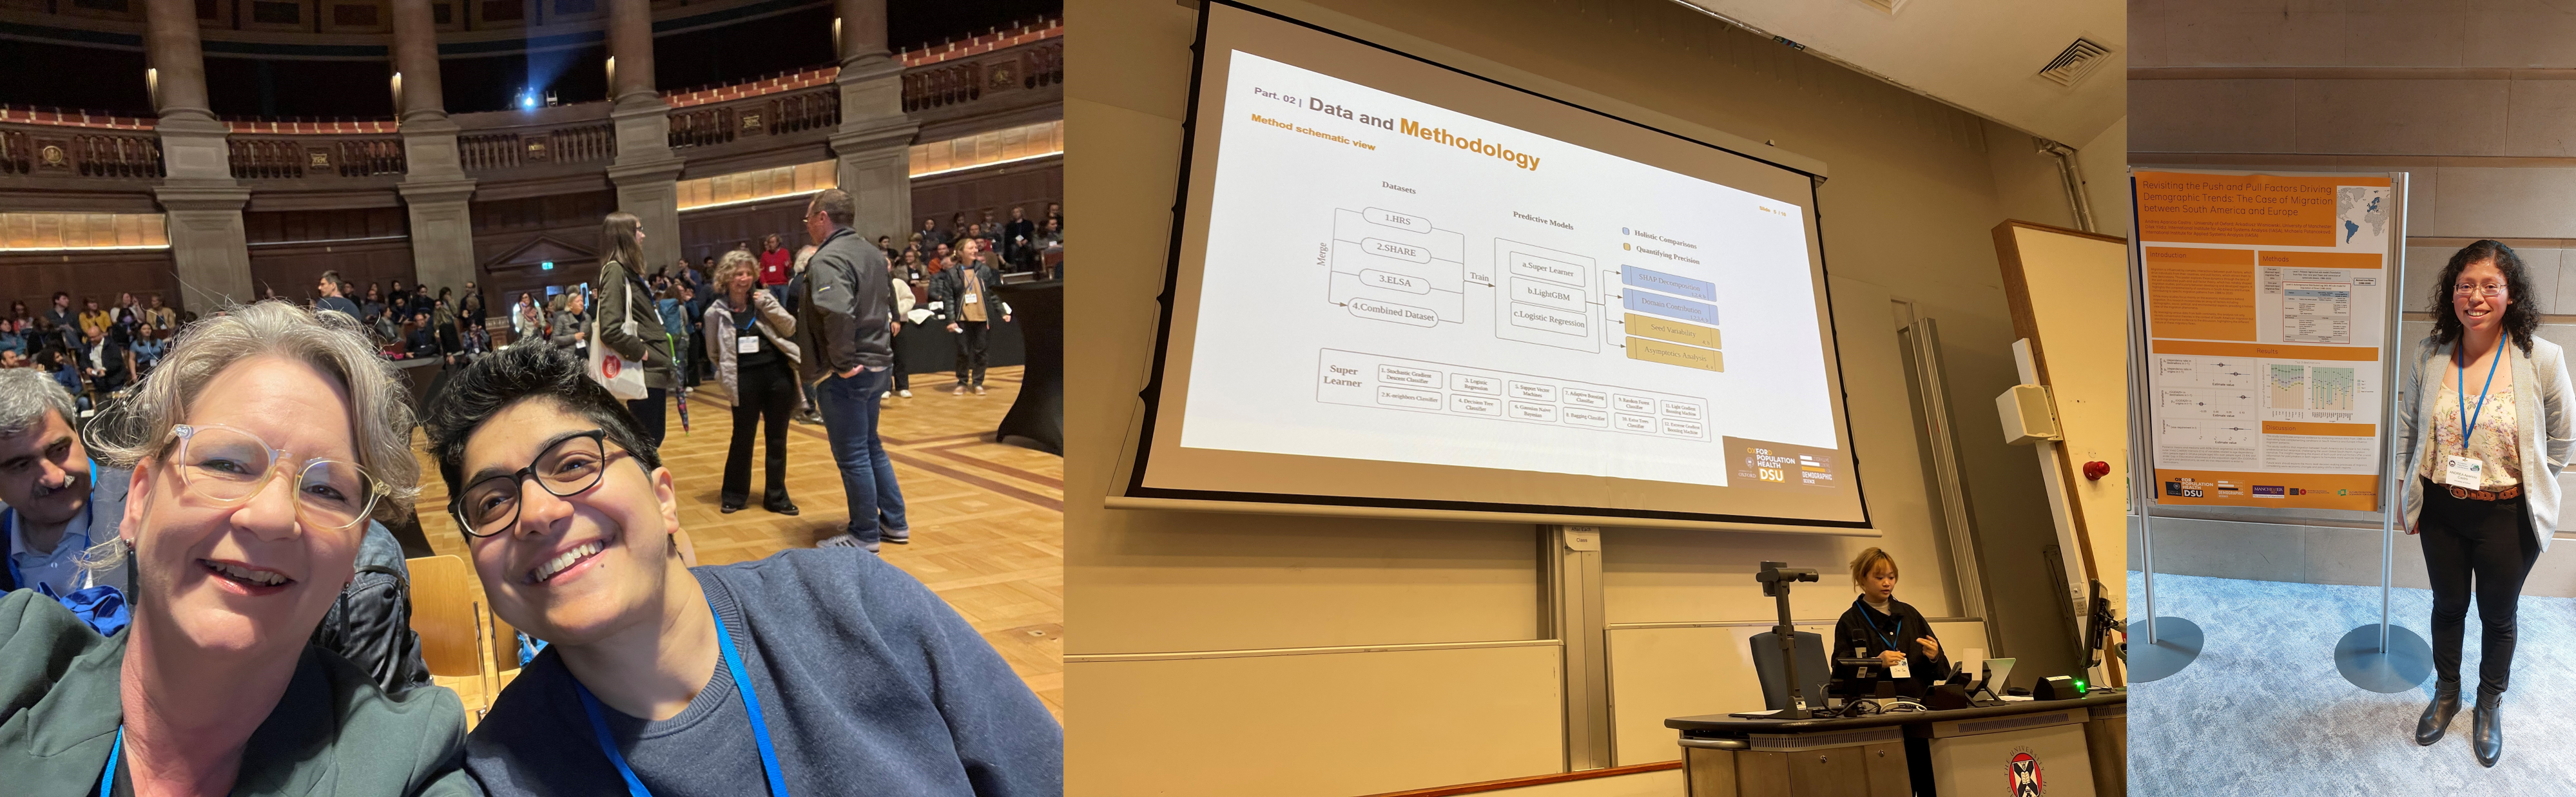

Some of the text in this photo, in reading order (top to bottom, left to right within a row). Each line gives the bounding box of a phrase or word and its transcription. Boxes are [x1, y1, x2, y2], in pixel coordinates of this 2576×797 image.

[1251, 113, 1376, 151] Method schematic view
[1254, 87, 1279, 101] Part.
[1283, 94, 1295, 104] 02
[1309, 97, 1353, 120] Data
[1359, 110, 1394, 131] and
[1400, 117, 1540, 171] Methodology
[1382, 181, 1417, 194] Datasets
[2143, 181, 2184, 191] Revisiting
[2202, 182, 2223, 191] Push
[2226, 183, 2243, 191] and
[2246, 183, 2261, 191] Pull
[2265, 184, 2298, 193] Factors
[2300, 184, 2332, 195] Driving
[2144, 192, 2332, 207] Demographic Trends: The Case of Migration
[2144, 204, 2298, 217] between South America and Europe
[1385, 214, 1411, 226] 1.HRS
[1513, 211, 1574, 231] Predictive Models
[1634, 229, 1698, 249] Holistic Comparisons
[1317, 242, 1328, 267] Merge
[1377, 242, 1417, 257] 2.SHARE
[1636, 245, 1700, 265] Quantifying Precision
[1470, 272, 1489, 282] Train
[1522, 261, 1574, 278] a.Super Learner
[1379, 274, 1412, 287] 3.ELSA
[1638, 273, 1700, 292] SHAP Decomposition
[1527, 287, 1571, 302] b.LightGBM
[1352, 302, 1435, 322] 4.Combined Dataset
[1641, 297, 1701, 314] Domain Contribution
[1513, 310, 1585, 329] c.Logistic Regression
[1651, 323, 1696, 338] Seed Variability
[1644, 346, 1707, 363] Asymptotics Analysis
[1330, 365, 1358, 376] Super
[1386, 369, 1411, 377] Stochastic
[1323, 376, 1362, 388] Learner
[1747, 447, 1772, 456] OXFORD
[1756, 455, 1796, 465] POPULATION
[1757, 461, 1781, 469] HEALTH
[1759, 468, 1783, 481] DSU
[1802, 471, 1832, 481] DEMOGRAPHIC
[2009, 745, 2045, 771] UNIVERSITY
